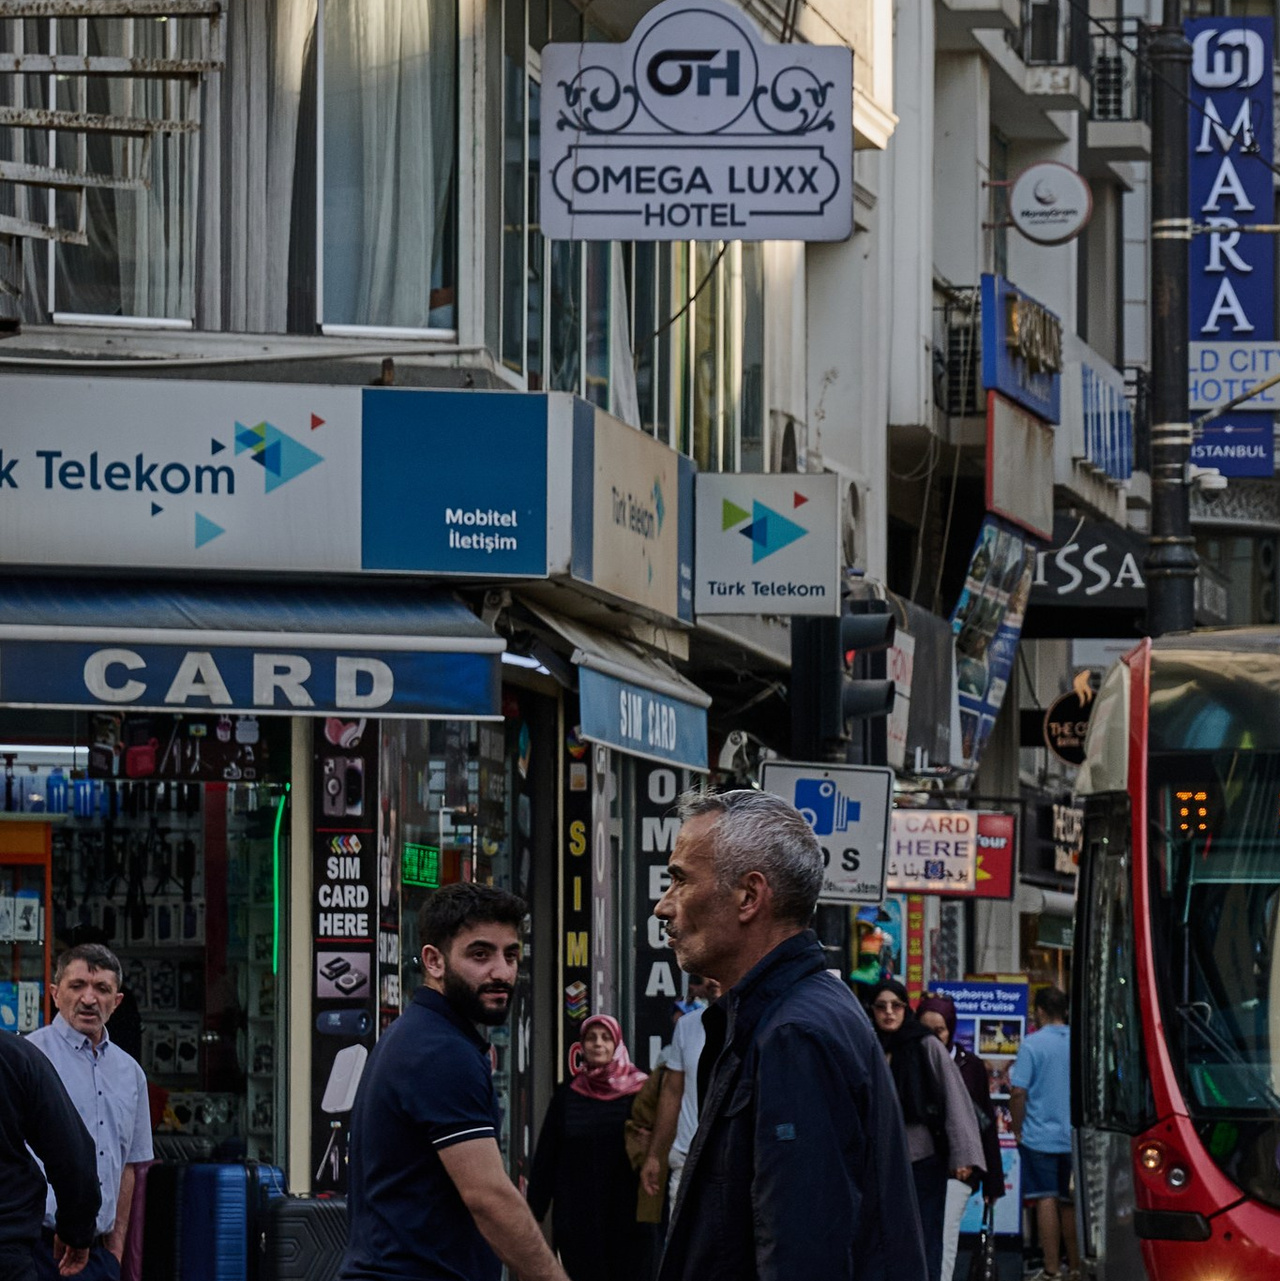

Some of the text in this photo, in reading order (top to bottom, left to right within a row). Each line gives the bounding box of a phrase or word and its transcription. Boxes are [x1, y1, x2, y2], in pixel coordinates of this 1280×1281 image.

[572, 165, 820, 194] OMEGA LUXX
[644, 203, 747, 227] HOTEL
[36, 450, 235, 496] Telekom
[445, 507, 517, 528] Mobitel
[449, 528, 517, 554] İletişim
[708, 580, 745, 596] Türk
[752, 581, 825, 596] Telekom
[83, 648, 394, 709] CARD
[619, 690, 677, 752] SIM CARD
[905, 816, 970, 834] CARD
[896, 839, 969, 858] HERE
[326, 856, 361, 880] SIM
[318, 884, 370, 908] CARD
[319, 913, 369, 937] HERE
[995, 989, 1022, 1002] Tour
